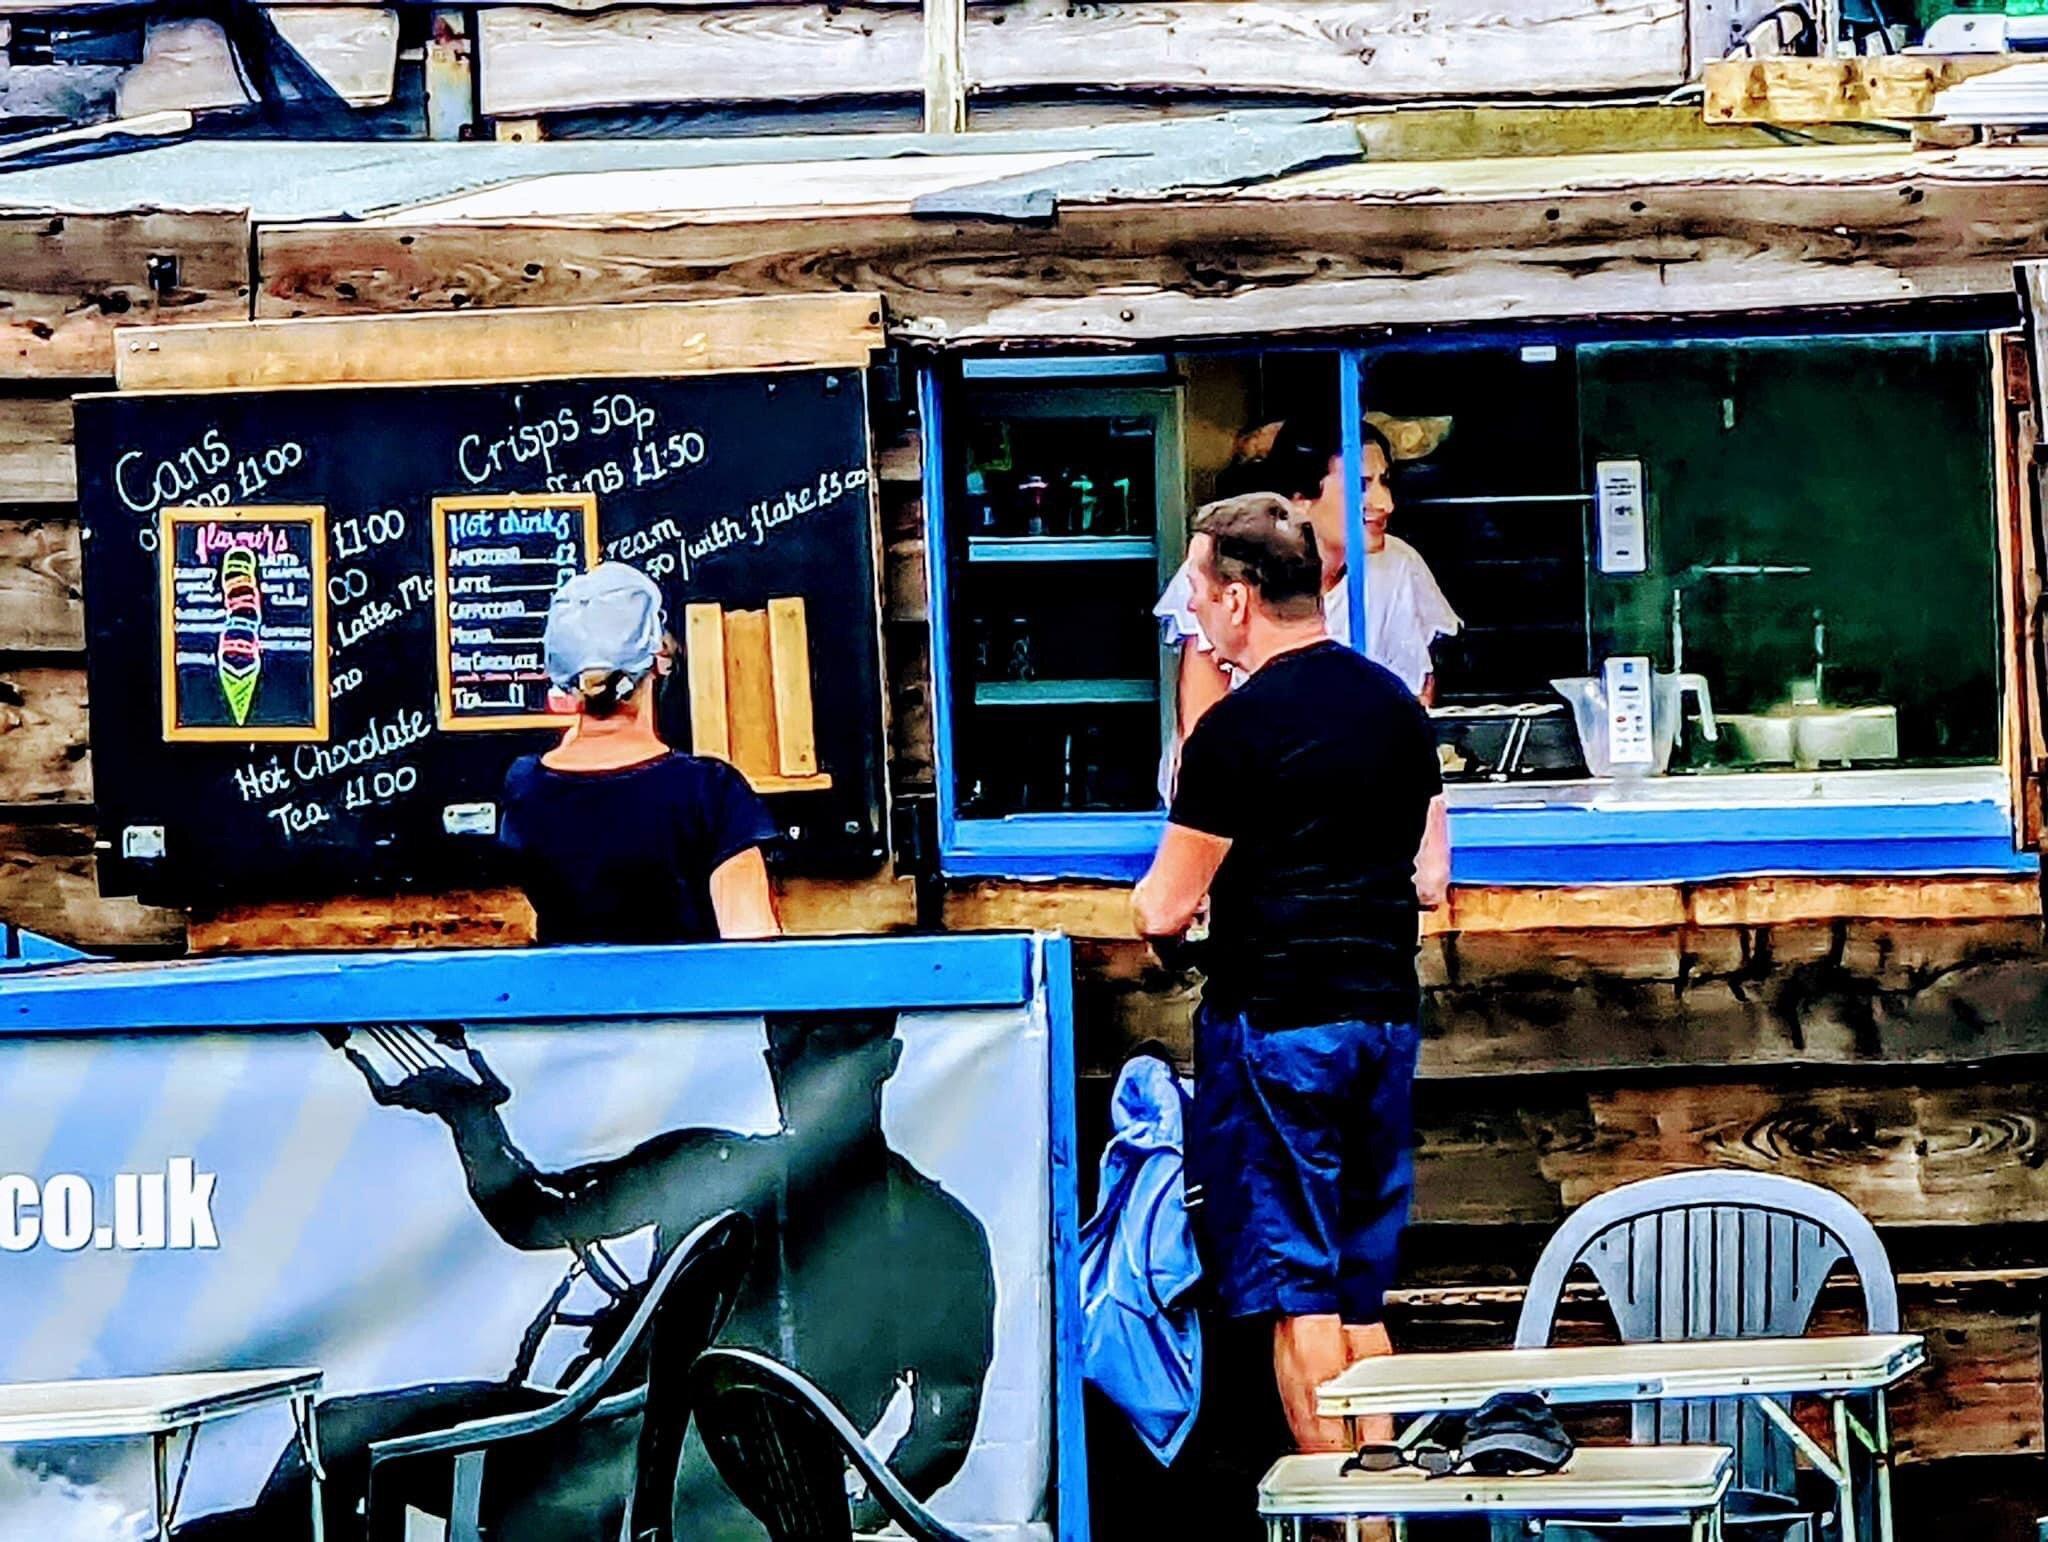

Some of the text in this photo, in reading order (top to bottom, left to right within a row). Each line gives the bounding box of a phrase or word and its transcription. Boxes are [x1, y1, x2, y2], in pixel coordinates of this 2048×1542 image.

[115, 429, 230, 512] Cans
[459, 394, 655, 484] Crisps 50p
[448, 507, 571, 544] Hot drinks
[751, 487, 817, 546] flake
[234, 708, 432, 800] Hot Chocolate
[267, 802, 331, 836] Tea
[0, 1156, 221, 1251] co.uk
